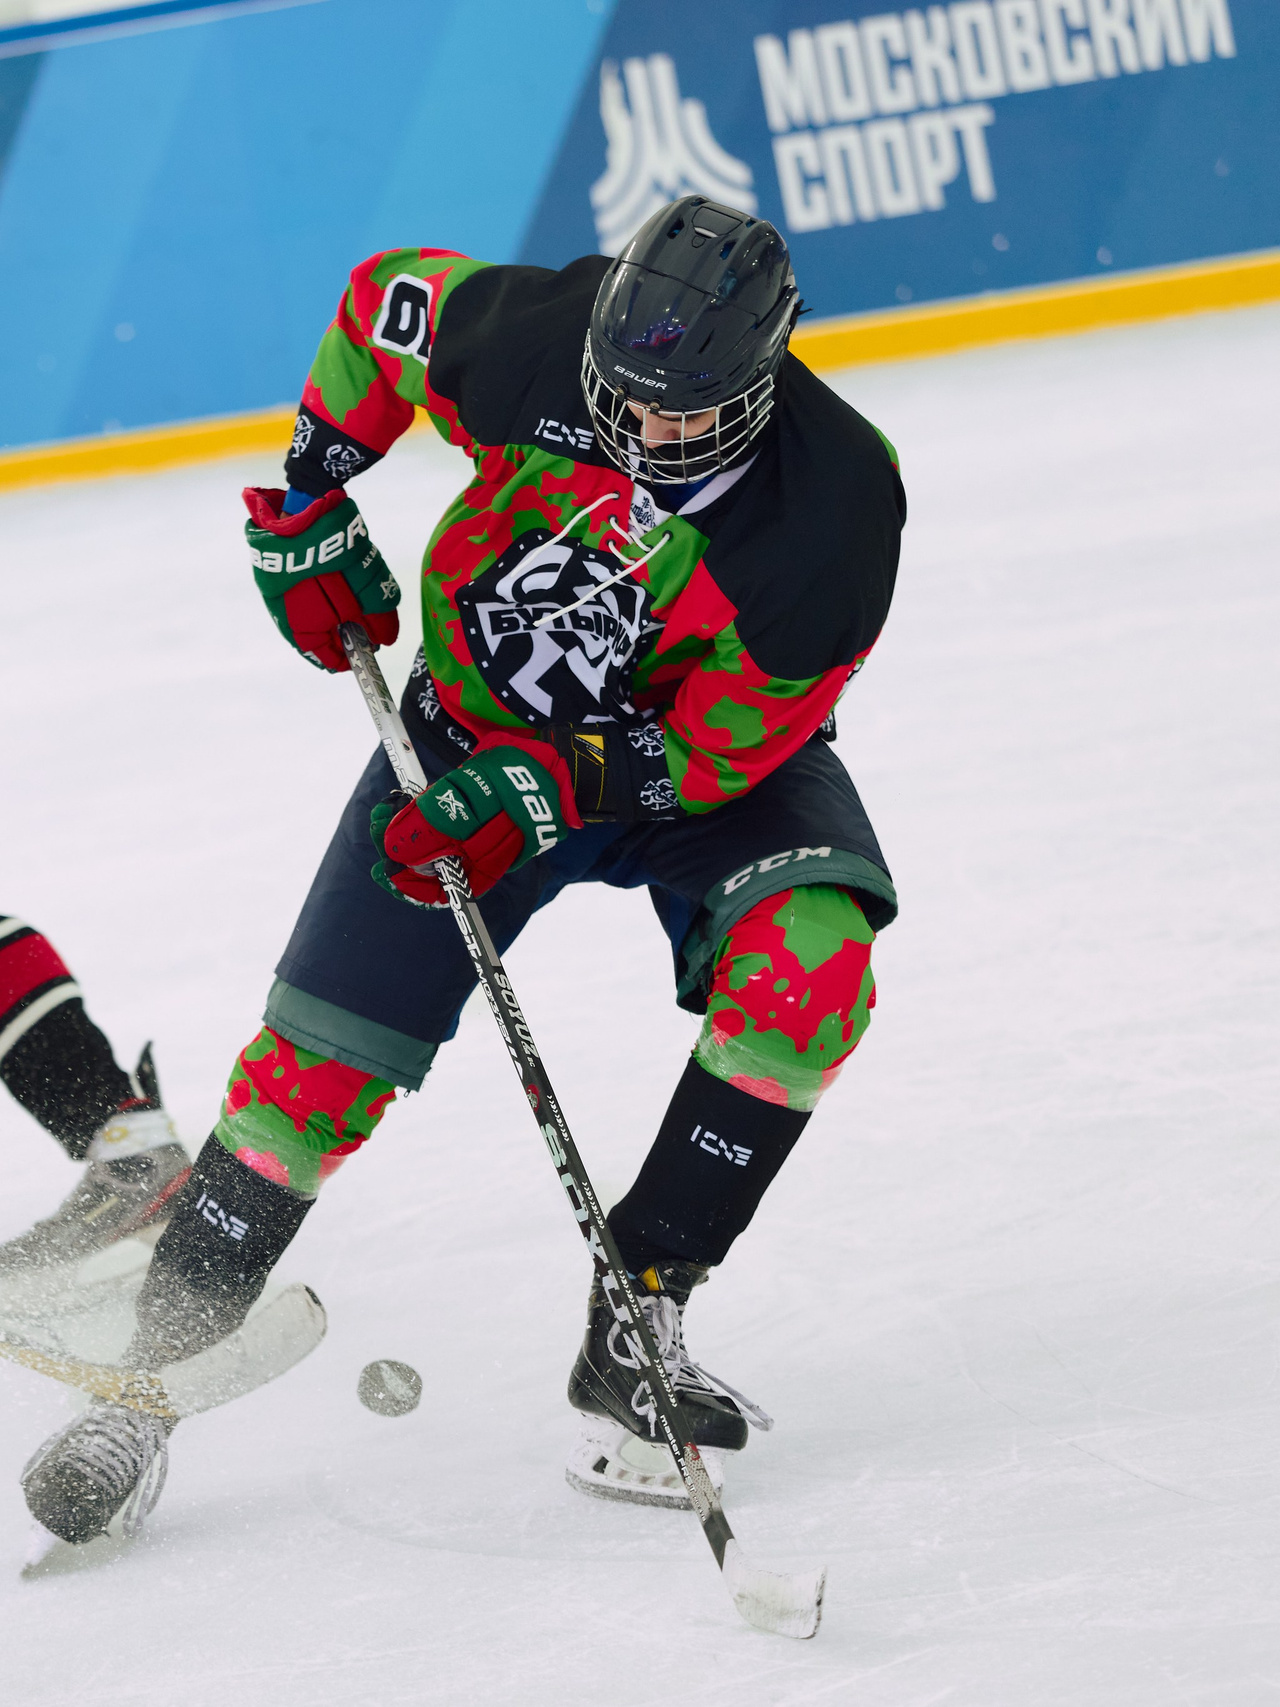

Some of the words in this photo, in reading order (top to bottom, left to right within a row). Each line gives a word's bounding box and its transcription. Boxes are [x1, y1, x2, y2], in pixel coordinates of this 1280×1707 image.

[773, 103, 997, 233] СПОРТ
[473, 774, 493, 797] BARS
[722, 846, 832, 896] CCM
[494, 971, 540, 1059] SOYUZ
[540, 1122, 651, 1370] SOYUZ
[660, 1414, 681, 1457] master
